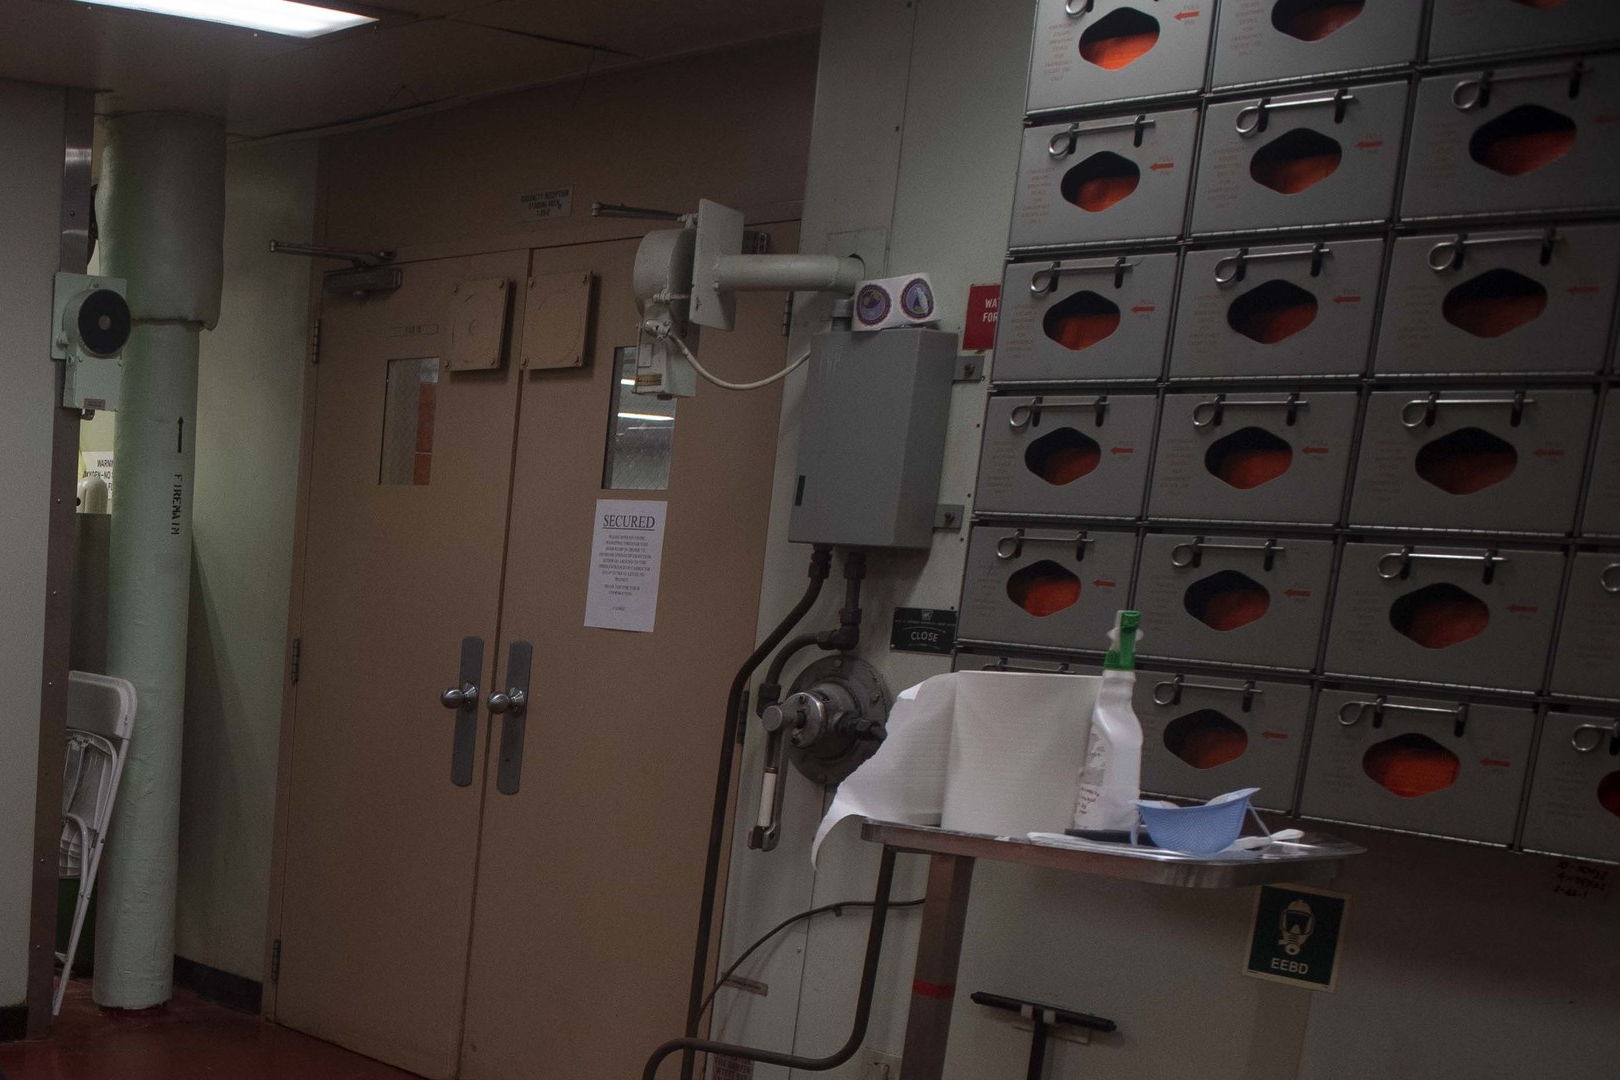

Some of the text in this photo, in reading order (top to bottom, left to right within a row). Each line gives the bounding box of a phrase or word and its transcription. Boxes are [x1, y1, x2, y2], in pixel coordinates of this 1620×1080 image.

[985, 296, 1001, 309] WA
[171, 474, 183, 536] FIREMAIN
[603, 514, 656, 529] SECURED
[910, 631, 940, 643] CLOSE
[1270, 957, 1309, 975] EEBD
